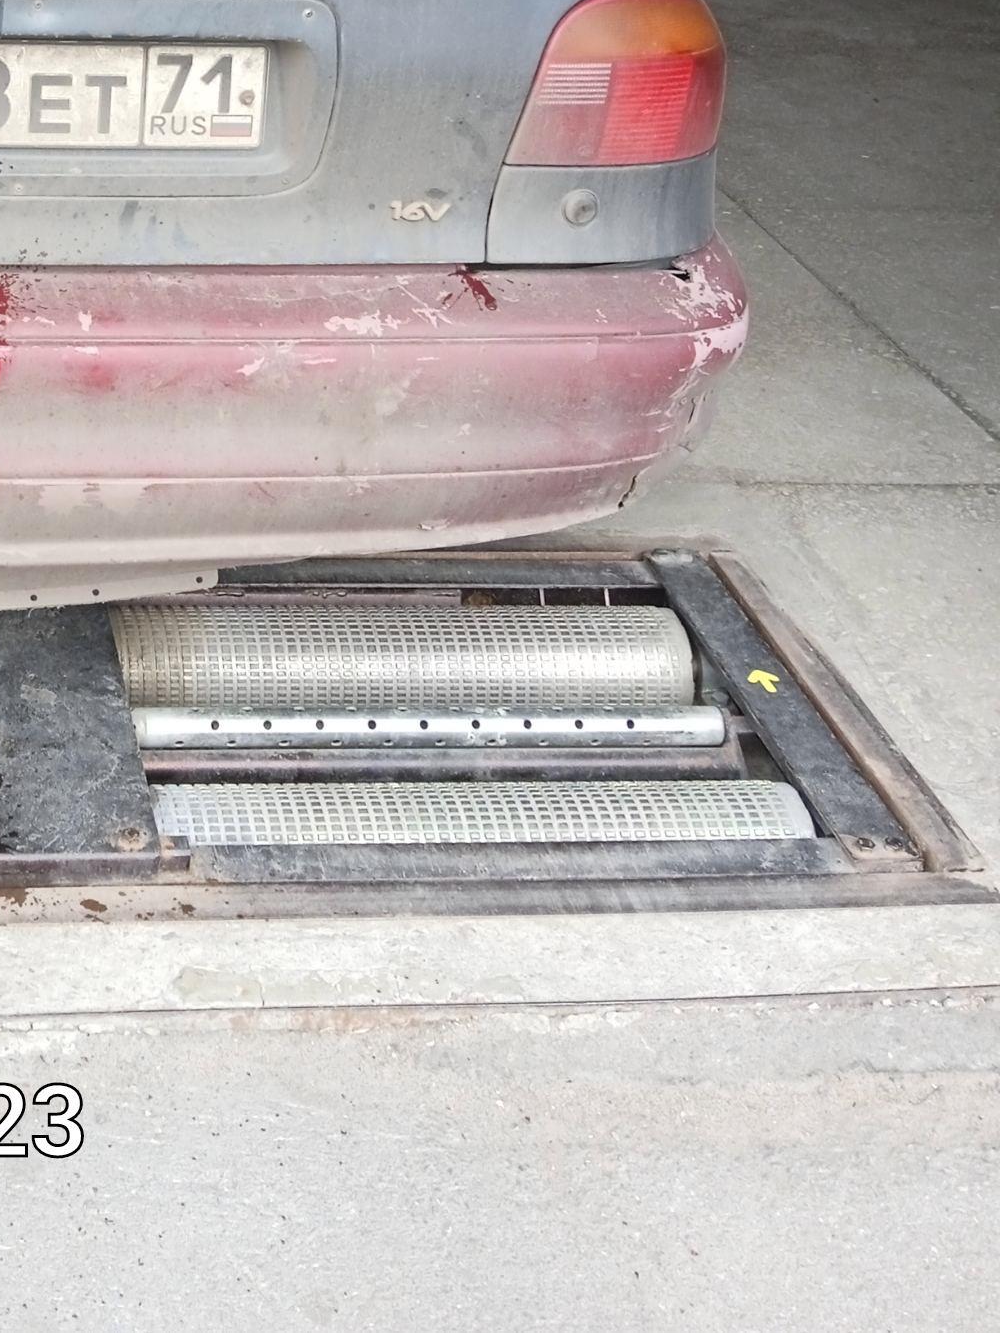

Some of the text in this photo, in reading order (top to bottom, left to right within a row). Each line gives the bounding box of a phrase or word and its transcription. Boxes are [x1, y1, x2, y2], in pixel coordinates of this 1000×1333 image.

[155, 54, 234, 115] 71
[149, 115, 207, 136] RUS
[389, 199, 451, 221] 16V
